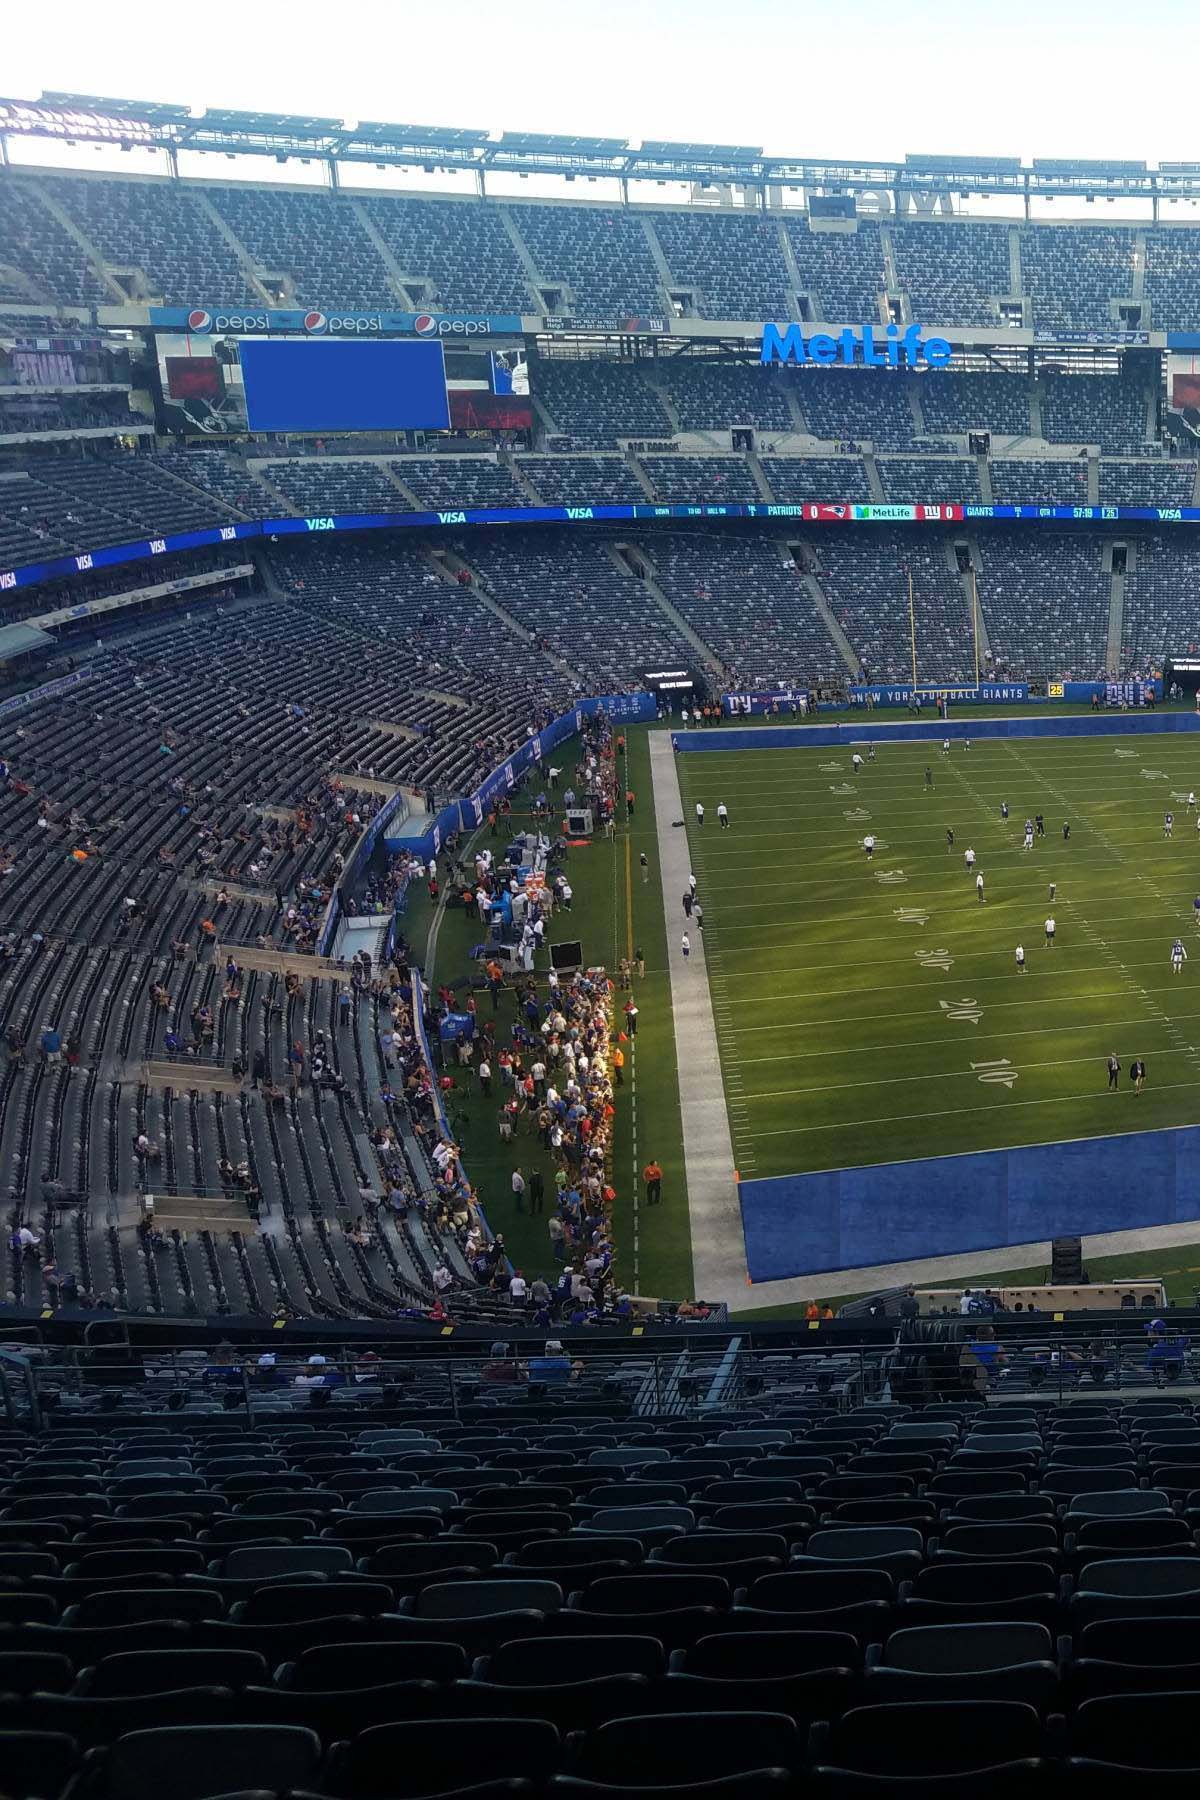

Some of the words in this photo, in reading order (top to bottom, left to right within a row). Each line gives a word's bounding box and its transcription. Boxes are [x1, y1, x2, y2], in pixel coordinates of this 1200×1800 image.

[216, 313, 270, 333] pepsi
[329, 313, 383, 334] pepsi
[439, 318, 491, 337] pepsi
[761, 323, 951, 368] MetLife
[565, 508, 594, 519] VISA
[768, 505, 803, 516] PATRIOTS
[811, 506, 818, 519] 0
[872, 506, 910, 517] MetLife
[946, 507, 953, 519] 0
[967, 506, 994, 517] GIANTS
[1073, 508, 1093, 518] 57:19
[1106, 509, 1115, 517] 25
[1157, 509, 1182, 520] VISA
[437, 511, 466, 524] VISA
[305, 518, 335, 531] VISA
[220, 527, 236, 540] VISA
[149, 540, 166, 554] VISA
[75, 554, 93, 570] VISA
[0, 572, 17, 590] VISA
[983, 689, 1023, 699] GIANTS
[1050, 685, 1063, 695] 25
[874, 870, 908, 884] 50
[893, 906, 930, 922] 40
[914, 948, 955, 967] 30
[939, 998, 984, 1020] 20
[969, 1058, 1019, 1083] 10
